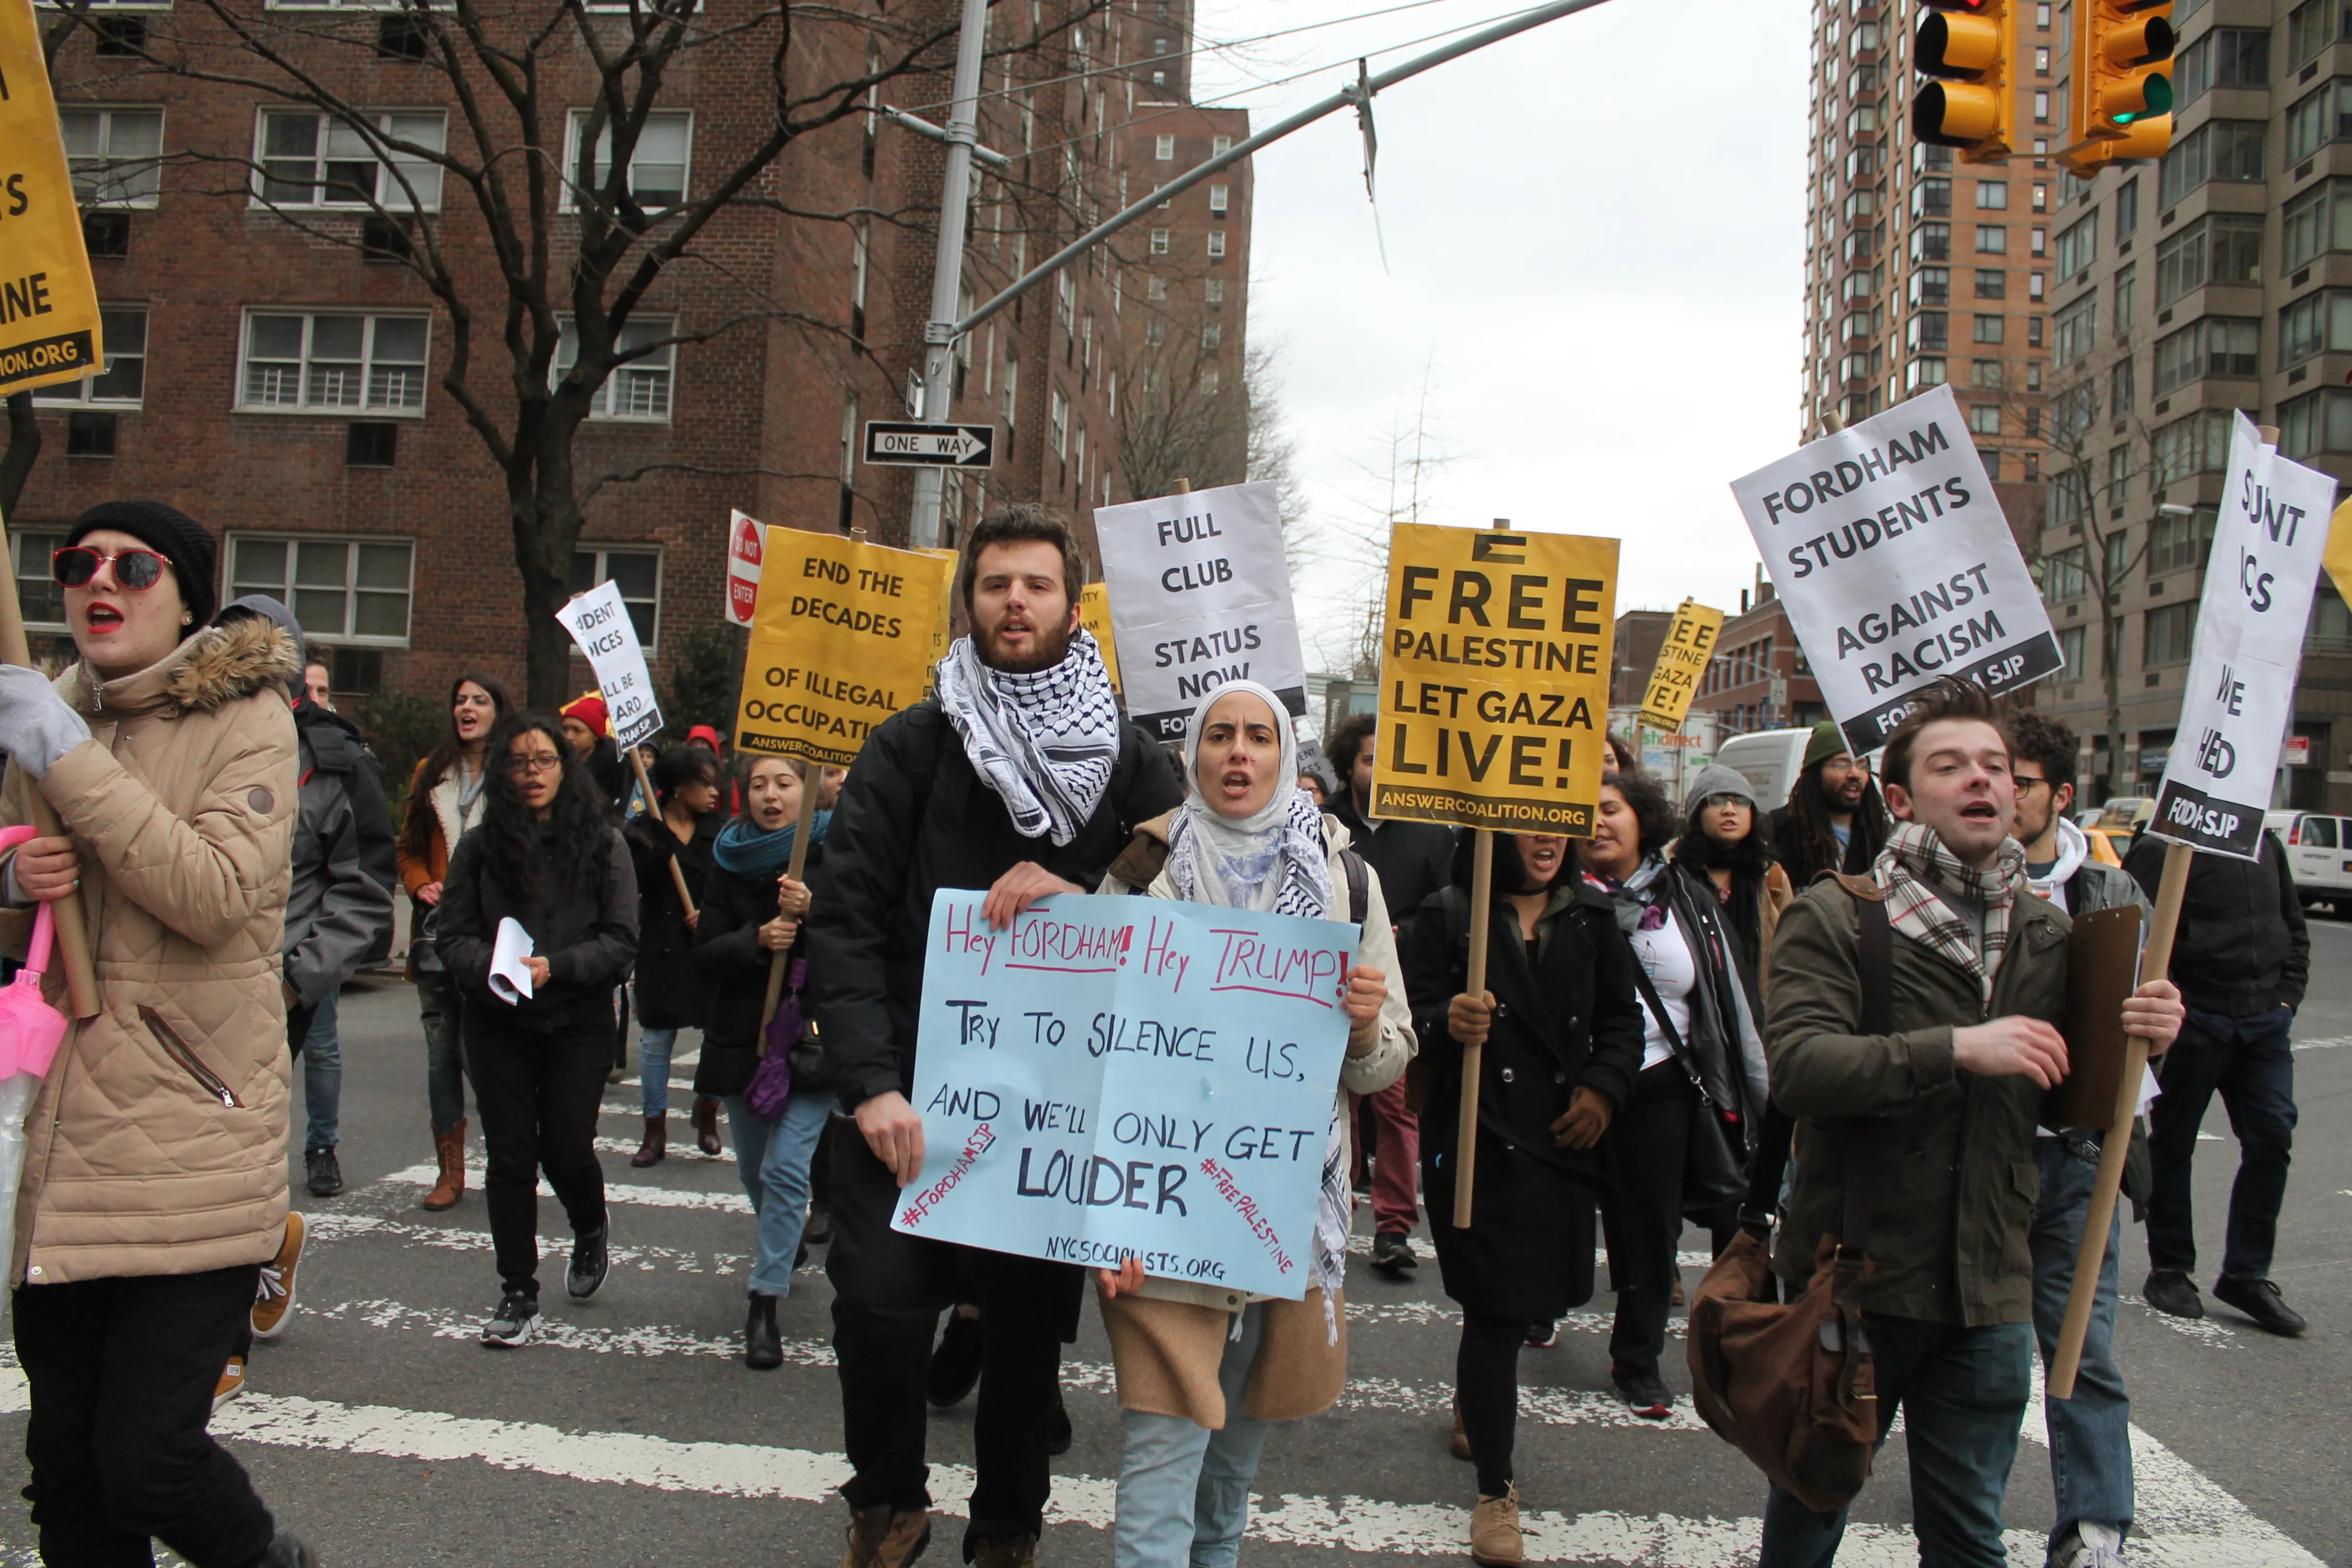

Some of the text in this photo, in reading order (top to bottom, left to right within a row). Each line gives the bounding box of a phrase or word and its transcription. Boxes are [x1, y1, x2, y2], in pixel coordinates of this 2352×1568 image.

[884, 435, 974, 454] ONE WAY
[1762, 422, 1950, 526] FORDHAM
[735, 535, 758, 558] DO NOT
[1157, 513, 1222, 547] FULL
[1788, 477, 1970, 579] STUDENTS
[733, 583, 753, 605] ENTER
[803, 558, 904, 597] END THE
[1161, 558, 1233, 593] CLUB
[790, 596, 902, 639] DECADES
[1399, 565, 1604, 635] FREE
[1837, 563, 1991, 660] AGAINST
[1154, 625, 1261, 668] STATUS
[1393, 629, 1599, 675] PALESTINE
[1860, 609, 2007, 695] RACISM
[621, 673, 634, 689] BE
[765, 667, 799, 687] OF
[805, 671, 899, 712] ILLEGAL
[1987, 655, 2024, 685] SJP
[1393, 680, 1593, 731] LET GAZA
[751, 737, 857, 764] ANSWERCOALITIO
[1391, 723, 1572, 790] LIVE!
[1381, 791, 1586, 825] ANSWERCOALITION.ORG
[945, 903, 1349, 999] Hey FORDHAM! Hey TRUMP!
[945, 1000, 1305, 1082] TRY TO SILENCE US,
[927, 1082, 1314, 1162] AND WE'LL ONLY GET
[1017, 1147, 1188, 1217] LOUDER
